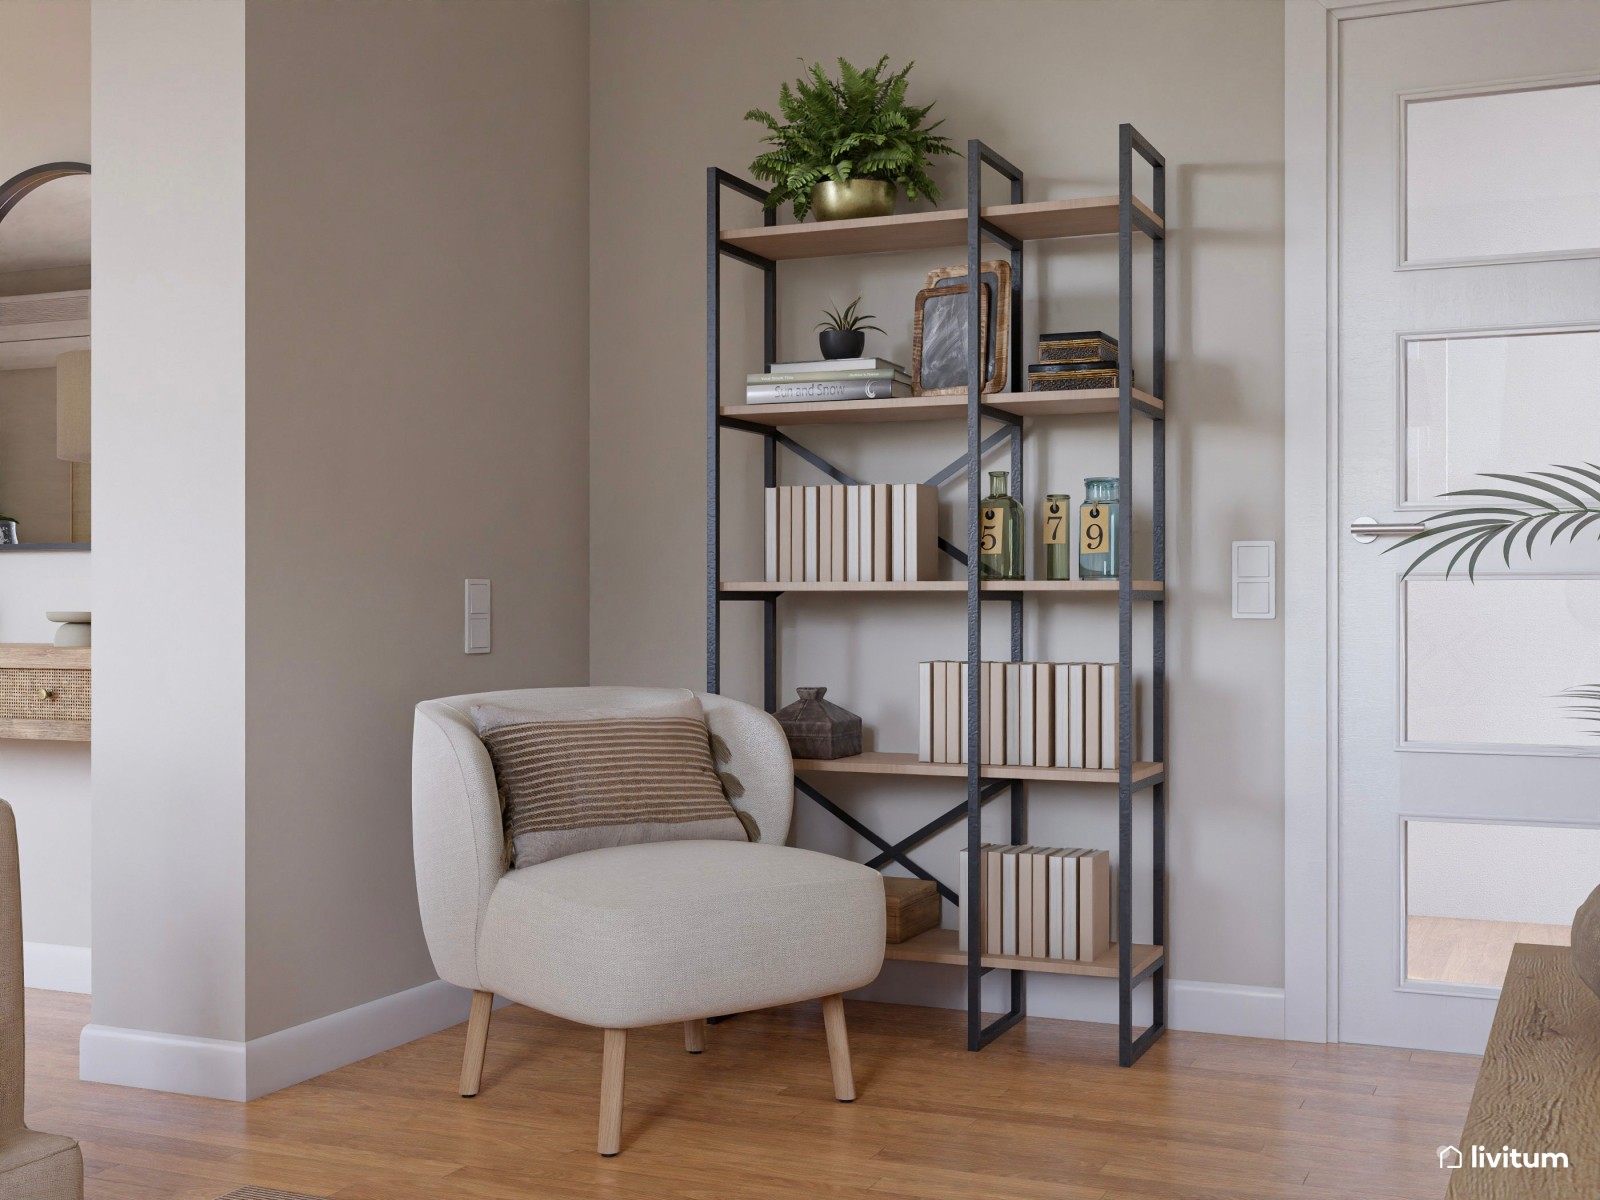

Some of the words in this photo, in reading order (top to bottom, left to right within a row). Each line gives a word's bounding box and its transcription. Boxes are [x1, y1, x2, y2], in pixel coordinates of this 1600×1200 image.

[774, 385, 793, 398] Sun
[796, 383, 815, 397] and
[817, 383, 845, 396] Snow
[980, 525, 997, 551] 5
[1047, 516, 1063, 541] 7
[1086, 523, 1104, 550] 9
